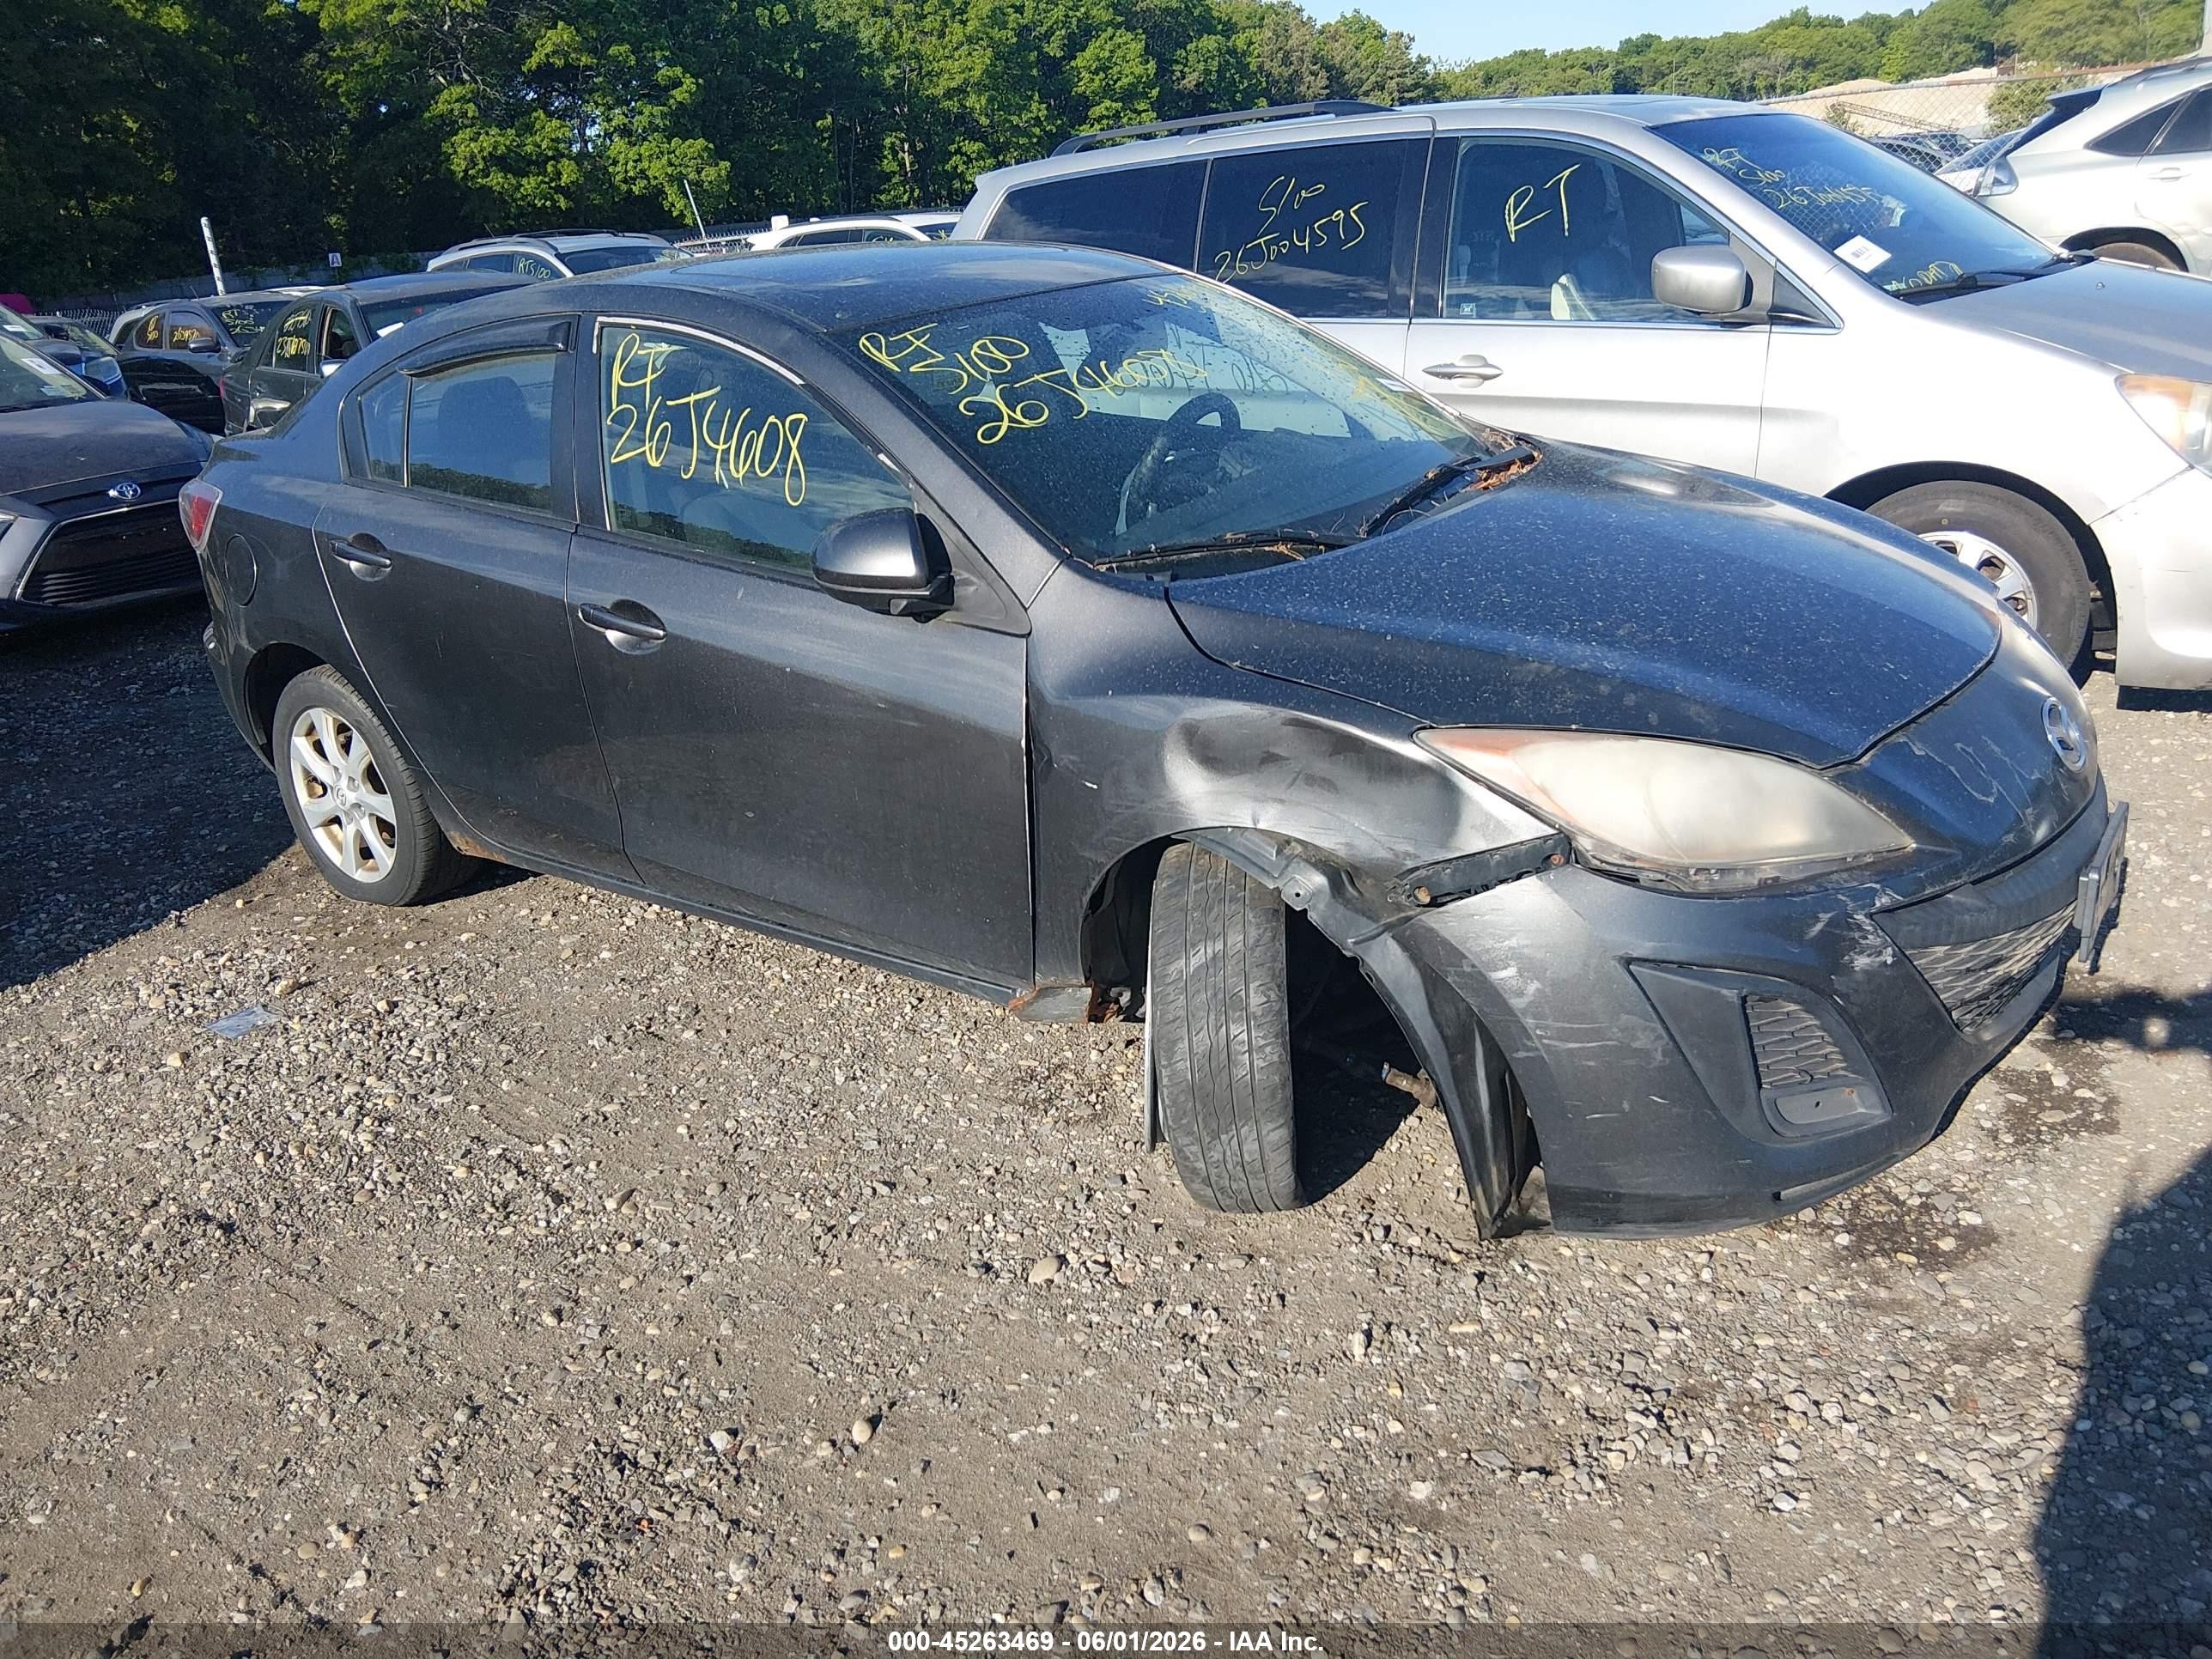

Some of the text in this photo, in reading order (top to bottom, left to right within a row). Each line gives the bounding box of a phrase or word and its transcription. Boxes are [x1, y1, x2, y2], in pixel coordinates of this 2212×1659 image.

[1504, 164, 1580, 243] RT
[331, 253, 341, 266] A
[611, 332, 677, 413] RT
[606, 384, 809, 507] 26J4608
